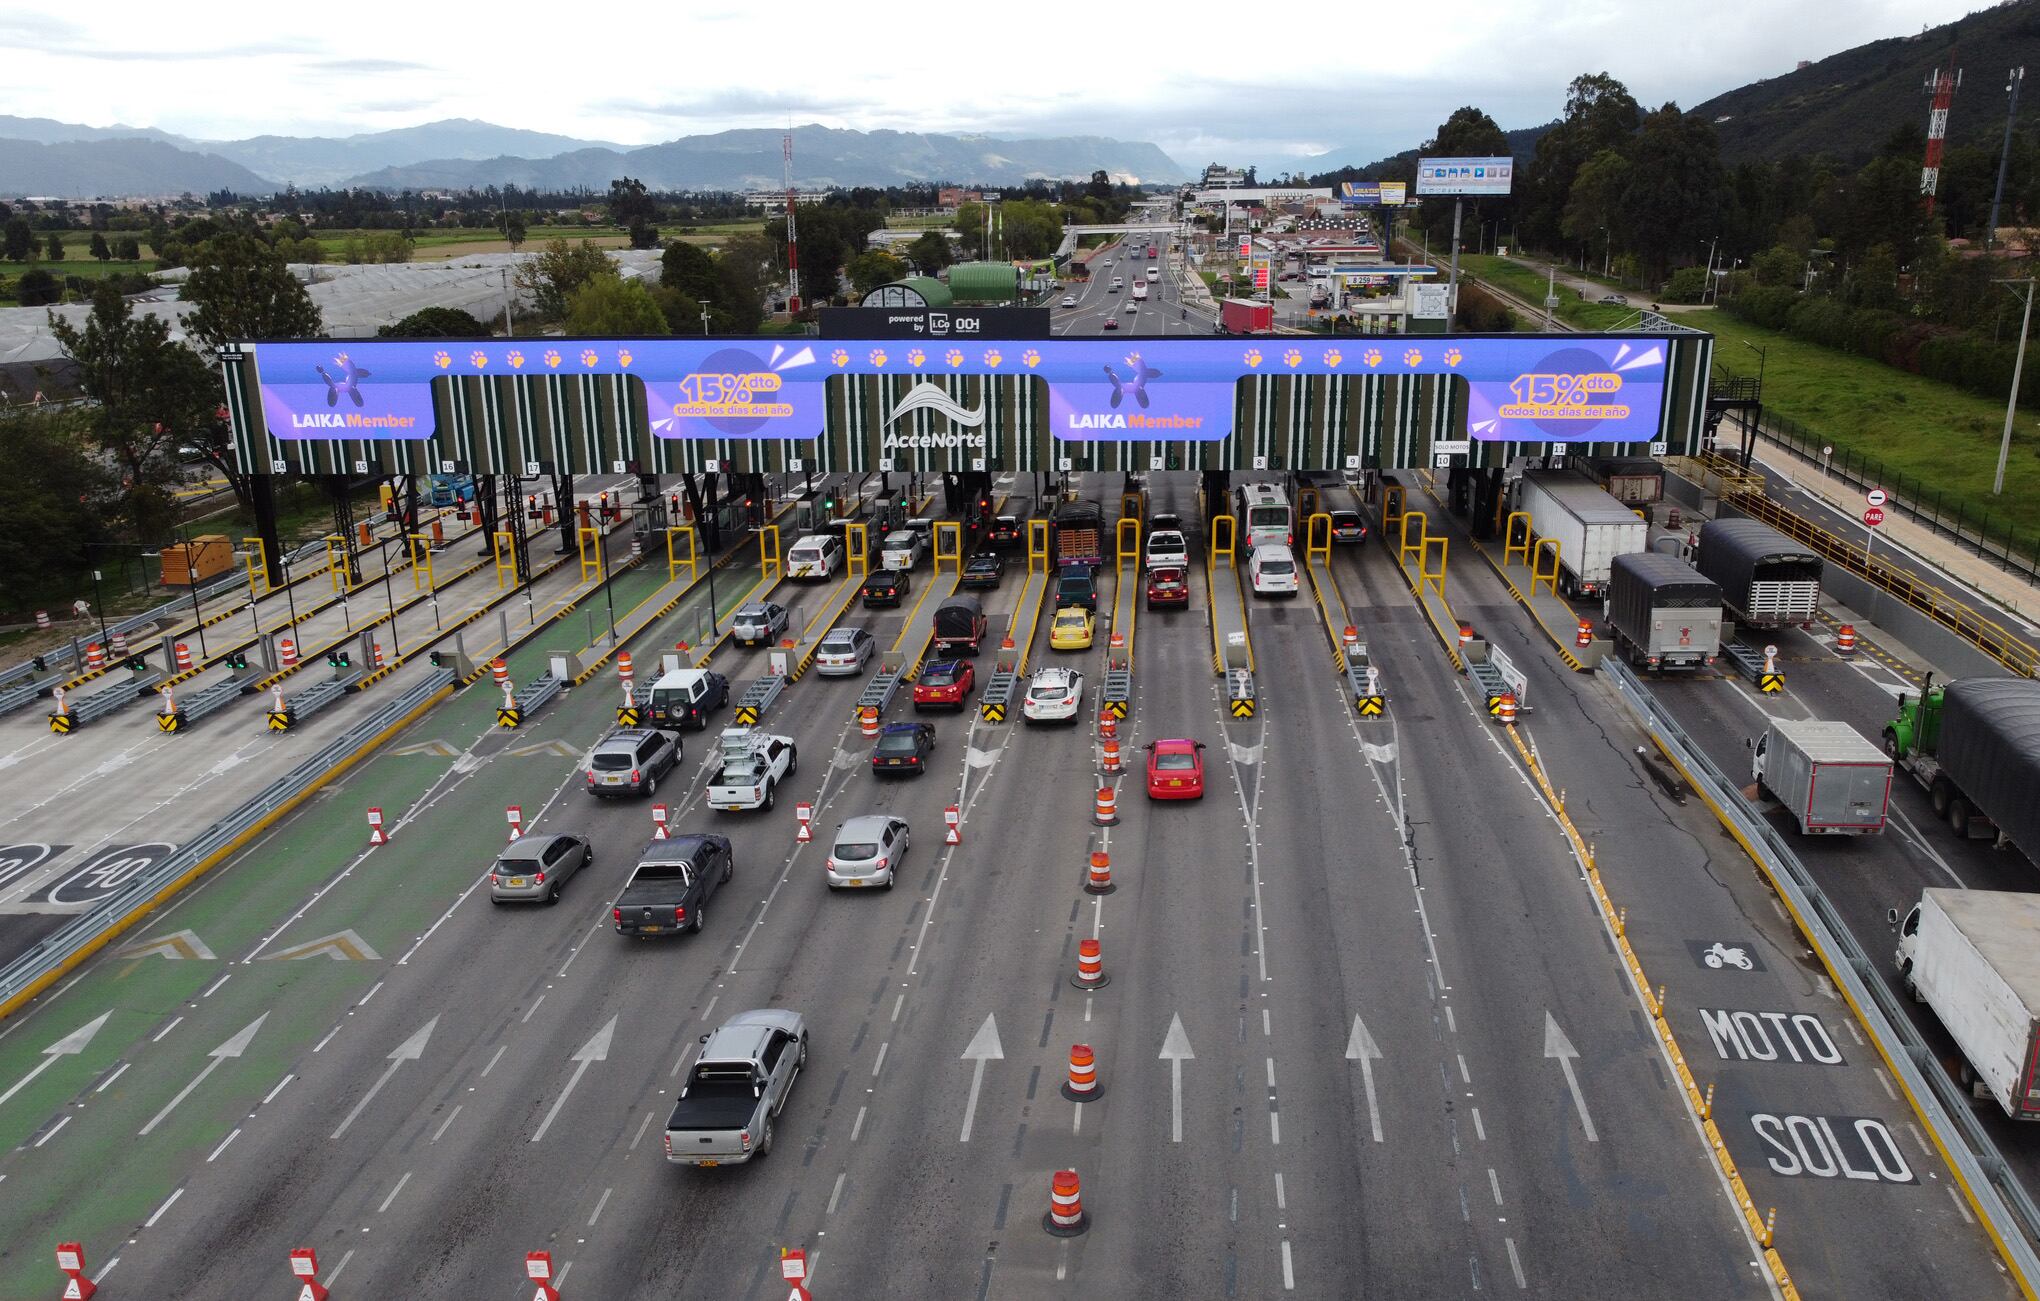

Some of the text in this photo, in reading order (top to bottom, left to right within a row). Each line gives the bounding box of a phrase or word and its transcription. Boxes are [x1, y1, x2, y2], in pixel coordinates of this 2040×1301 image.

[889, 315, 924, 324] powered
[914, 324, 924, 333] by
[681, 373, 778, 404] 15% dto.
[1511, 374, 1618, 405] 15% dto.
[677, 406, 706, 415] todos
[710, 406, 724, 415] los
[752, 406, 768, 415] del
[771, 406, 790, 415] año
[1503, 407, 1535, 416] todos
[1538, 407, 1555, 416] los
[1584, 407, 1602, 416] del
[1605, 407, 1627, 416] año
[292, 413, 416, 428] LAIKA Member
[1069, 413, 1203, 428] LAIKA Member
[884, 432, 986, 448] AcceNorte
[1062, 460, 1069, 468] 6
[1256, 458, 1263, 466] 8
[1350, 458, 1356, 466] 9
[1865, 513, 1882, 521] PARE
[1698, 1009, 1843, 1064] MOTO
[1750, 1113, 1914, 1182] SOLO
